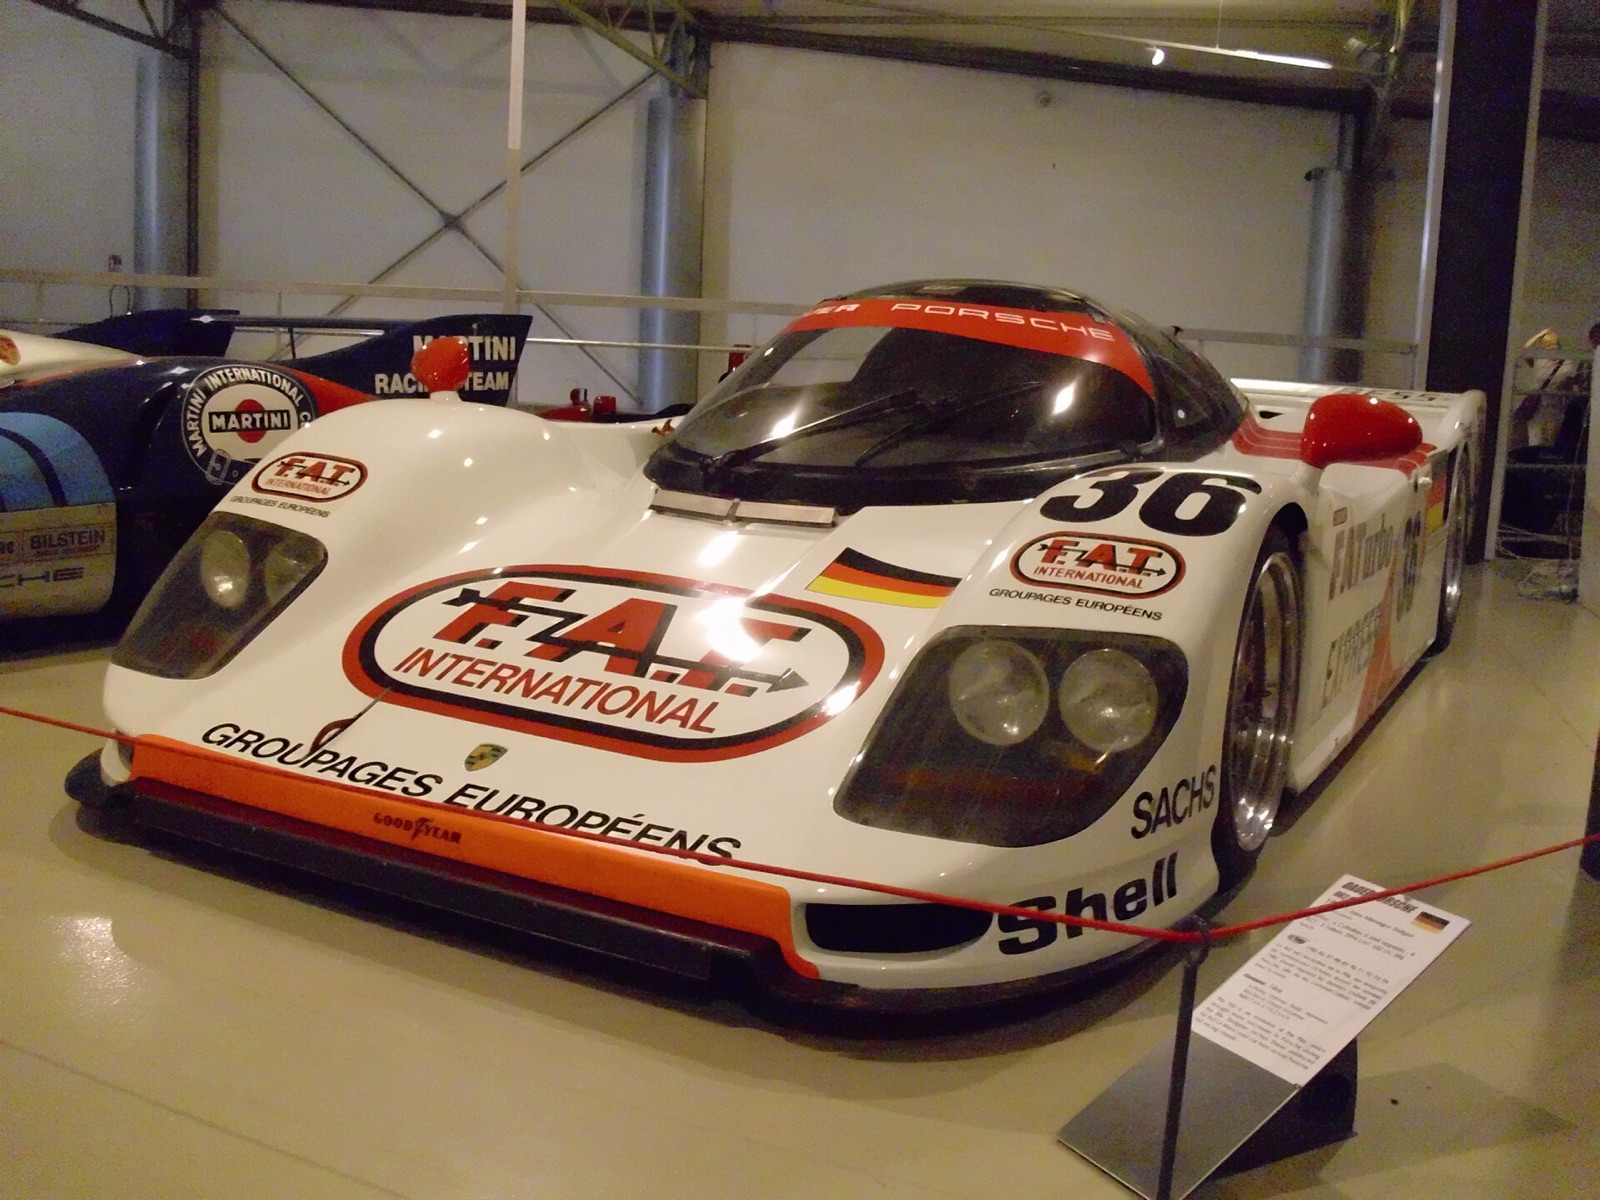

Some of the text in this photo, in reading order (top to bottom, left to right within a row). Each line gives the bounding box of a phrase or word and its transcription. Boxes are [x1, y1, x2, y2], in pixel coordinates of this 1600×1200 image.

[890, 302, 1116, 342] PORSCHE
[413, 335, 516, 361] MTINI
[374, 371, 509, 394] RACI TEAM
[186, 388, 207, 458] MARTINI
[204, 367, 304, 407] INTERNATIONAL
[211, 412, 289, 430] MARTINI
[265, 479, 332, 495] INTERNATIONAL
[1040, 467, 1262, 536] 36
[30, 529, 106, 549] BILSTEIN
[1033, 565, 1143, 589] INTERNATIONAL
[988, 587, 1163, 621] GROUPAGES EUROPÉENS
[392, 646, 720, 734] INTERNATIONAL
[201, 722, 742, 866] GROUPAGES EUROPÉENS
[1131, 764, 1217, 839] SACHS
[373, 812, 462, 844] GOODYEAR
[997, 850, 1179, 955] Shell
